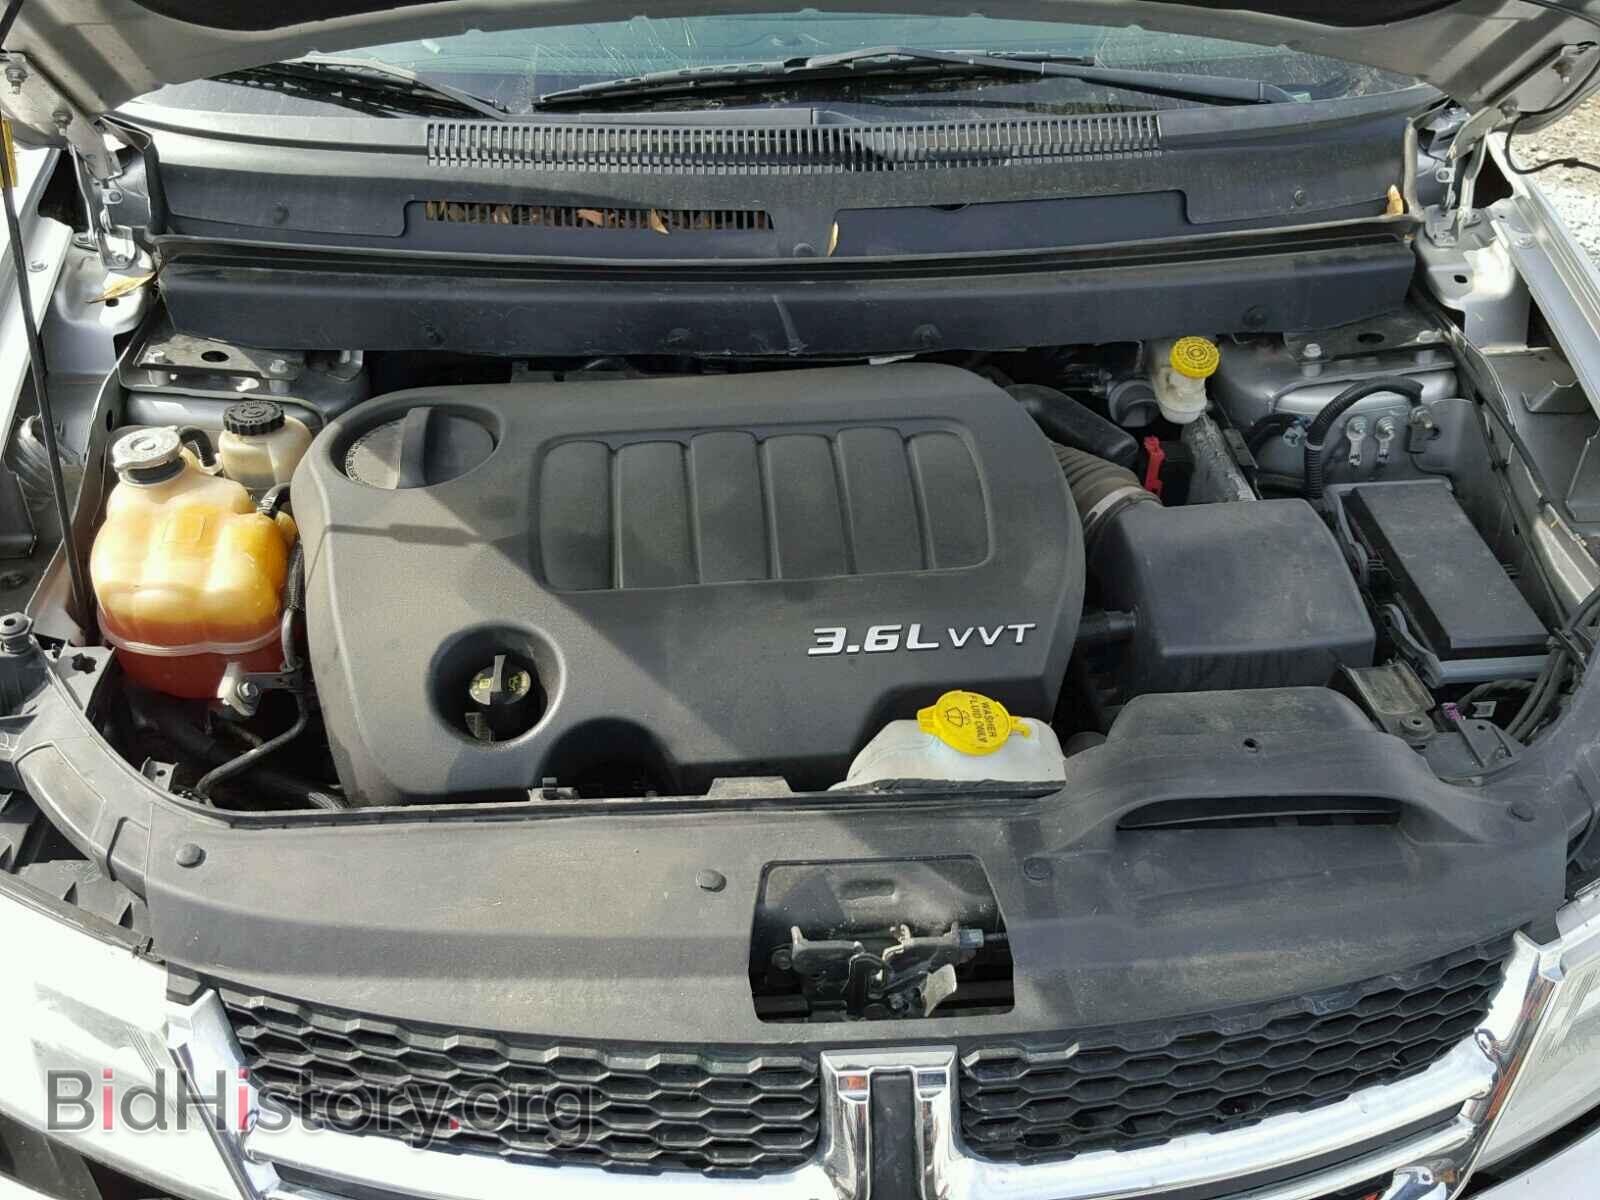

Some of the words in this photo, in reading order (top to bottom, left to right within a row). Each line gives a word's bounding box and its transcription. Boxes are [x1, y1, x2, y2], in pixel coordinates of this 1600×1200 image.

[807, 624, 940, 656] 3.6L
[948, 623, 1037, 648] VVT
[968, 695, 982, 719] FLUID
[975, 720, 988, 743] ONLY
[981, 701, 998, 738] WASHER
